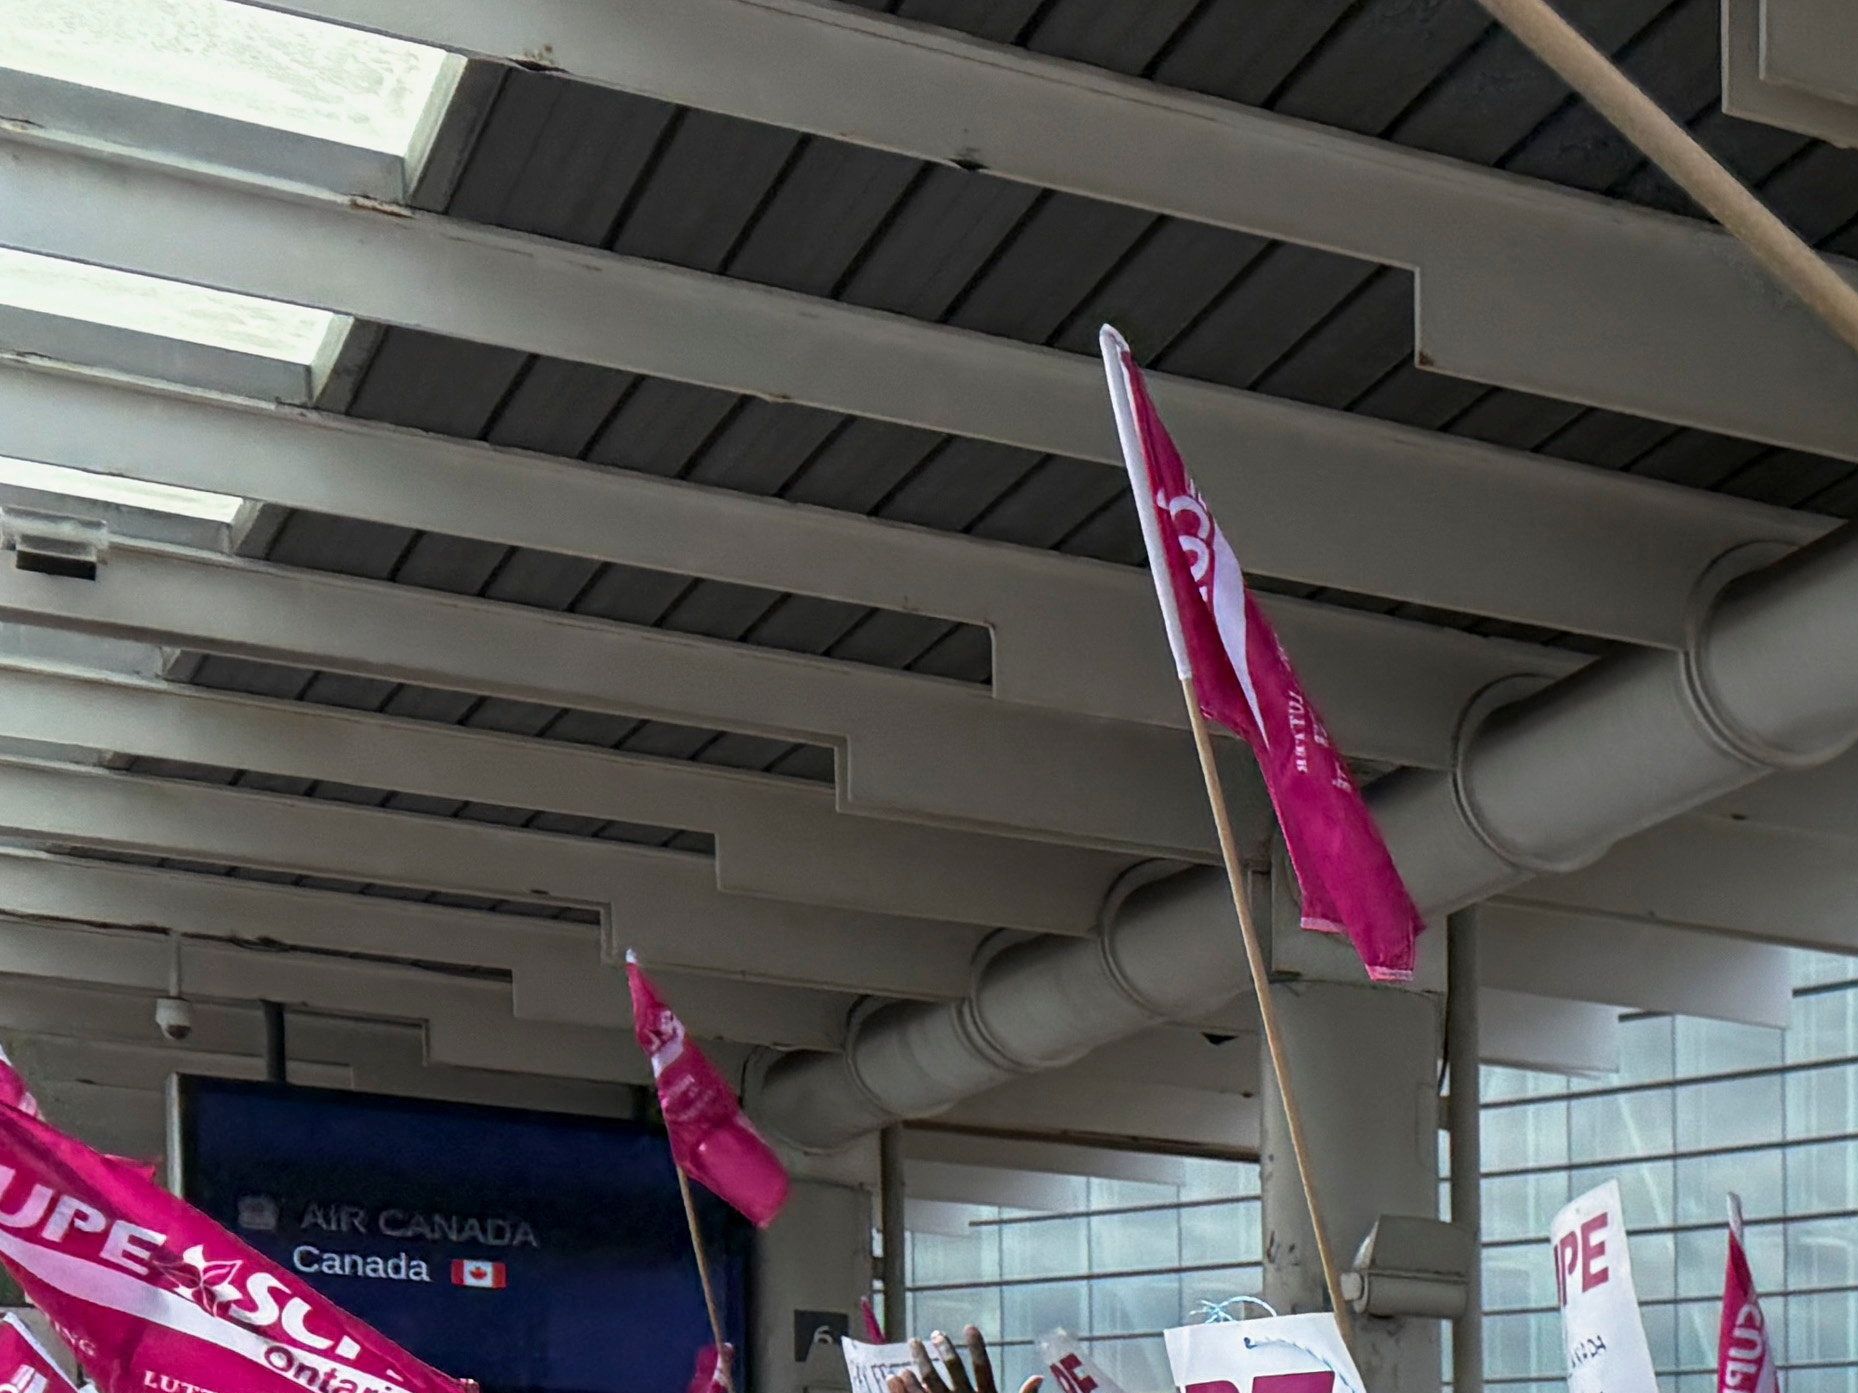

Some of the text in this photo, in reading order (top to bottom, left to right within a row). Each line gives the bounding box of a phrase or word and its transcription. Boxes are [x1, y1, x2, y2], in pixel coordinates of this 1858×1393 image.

[299, 1200, 539, 1249] AIR CANADA
[292, 1244, 434, 1283] Canada
